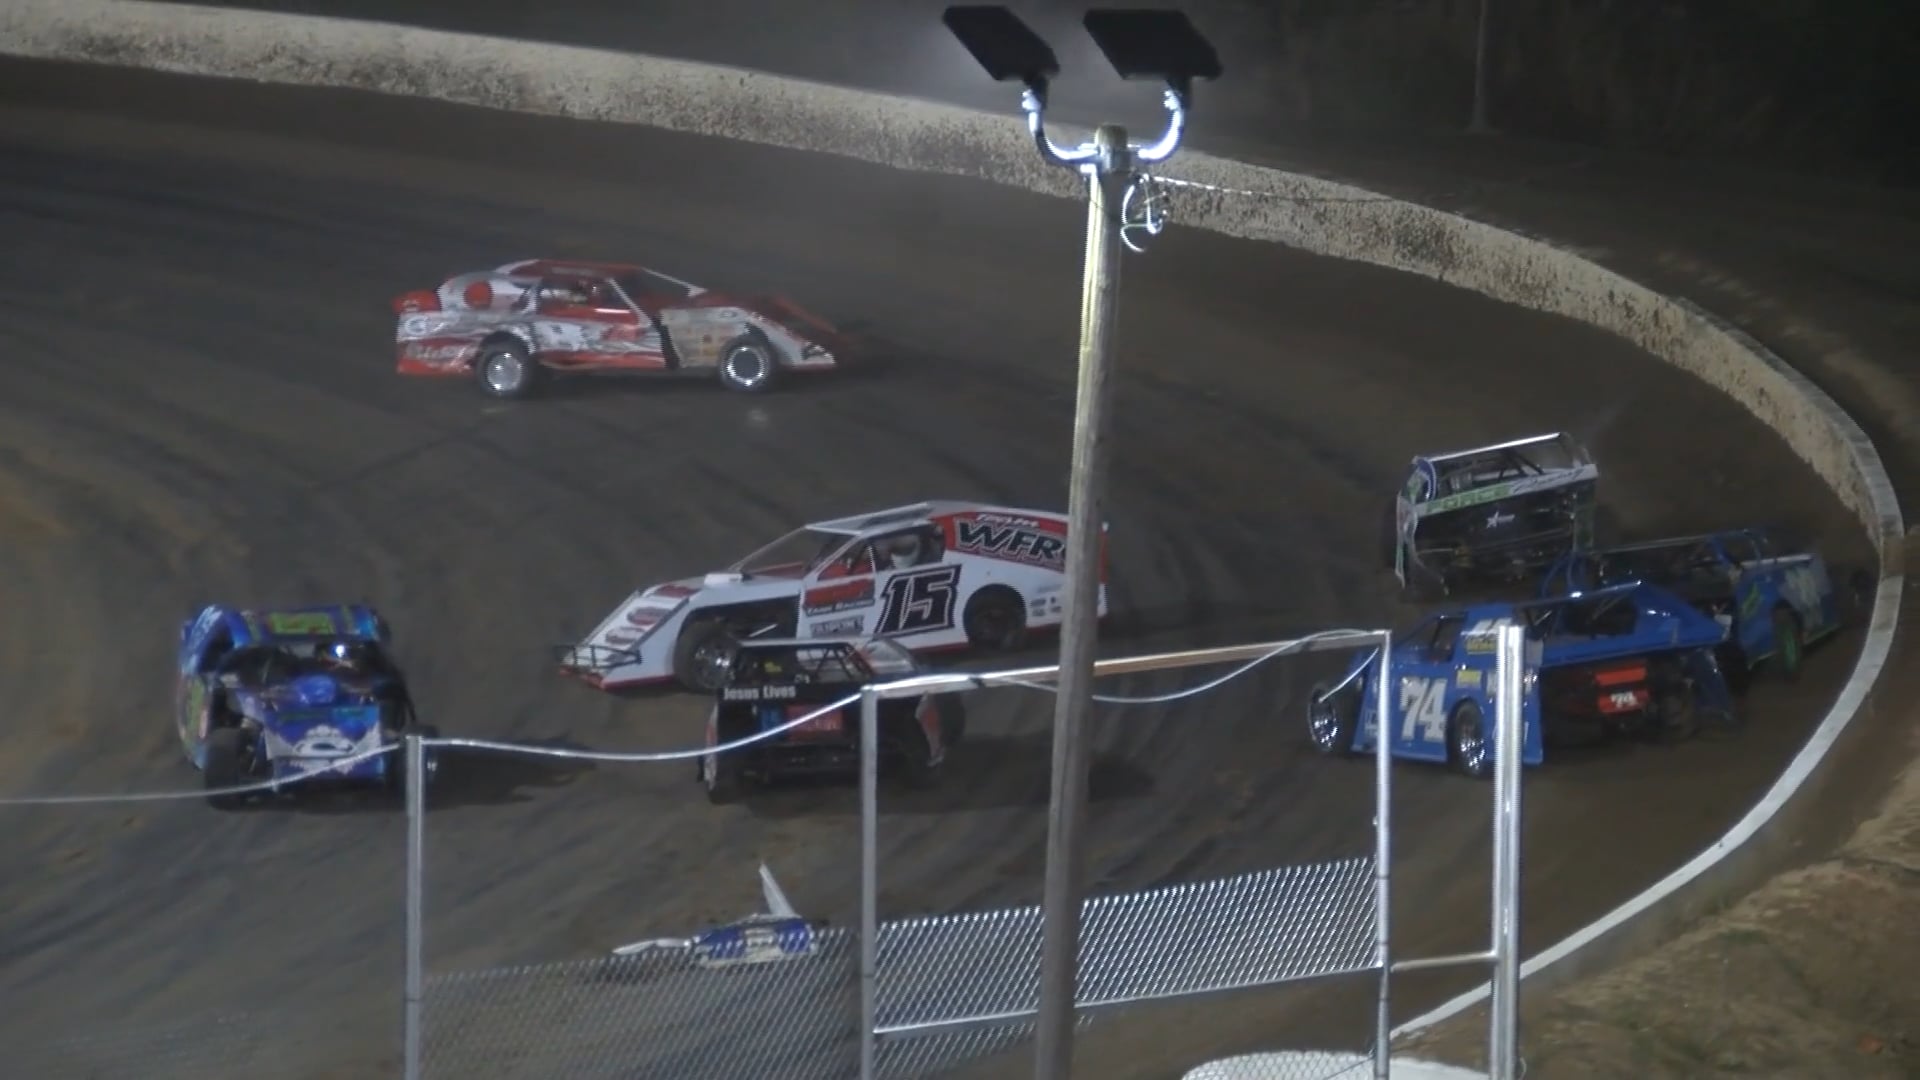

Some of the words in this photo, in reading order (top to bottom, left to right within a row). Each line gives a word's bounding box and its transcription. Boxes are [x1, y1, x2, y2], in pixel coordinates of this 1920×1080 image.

[956, 519, 1066, 568] WFR
[874, 564, 963, 639] 15
[723, 687, 760, 700] Jesus
[762, 685, 797, 699] Lives
[1399, 676, 1449, 742] 74
